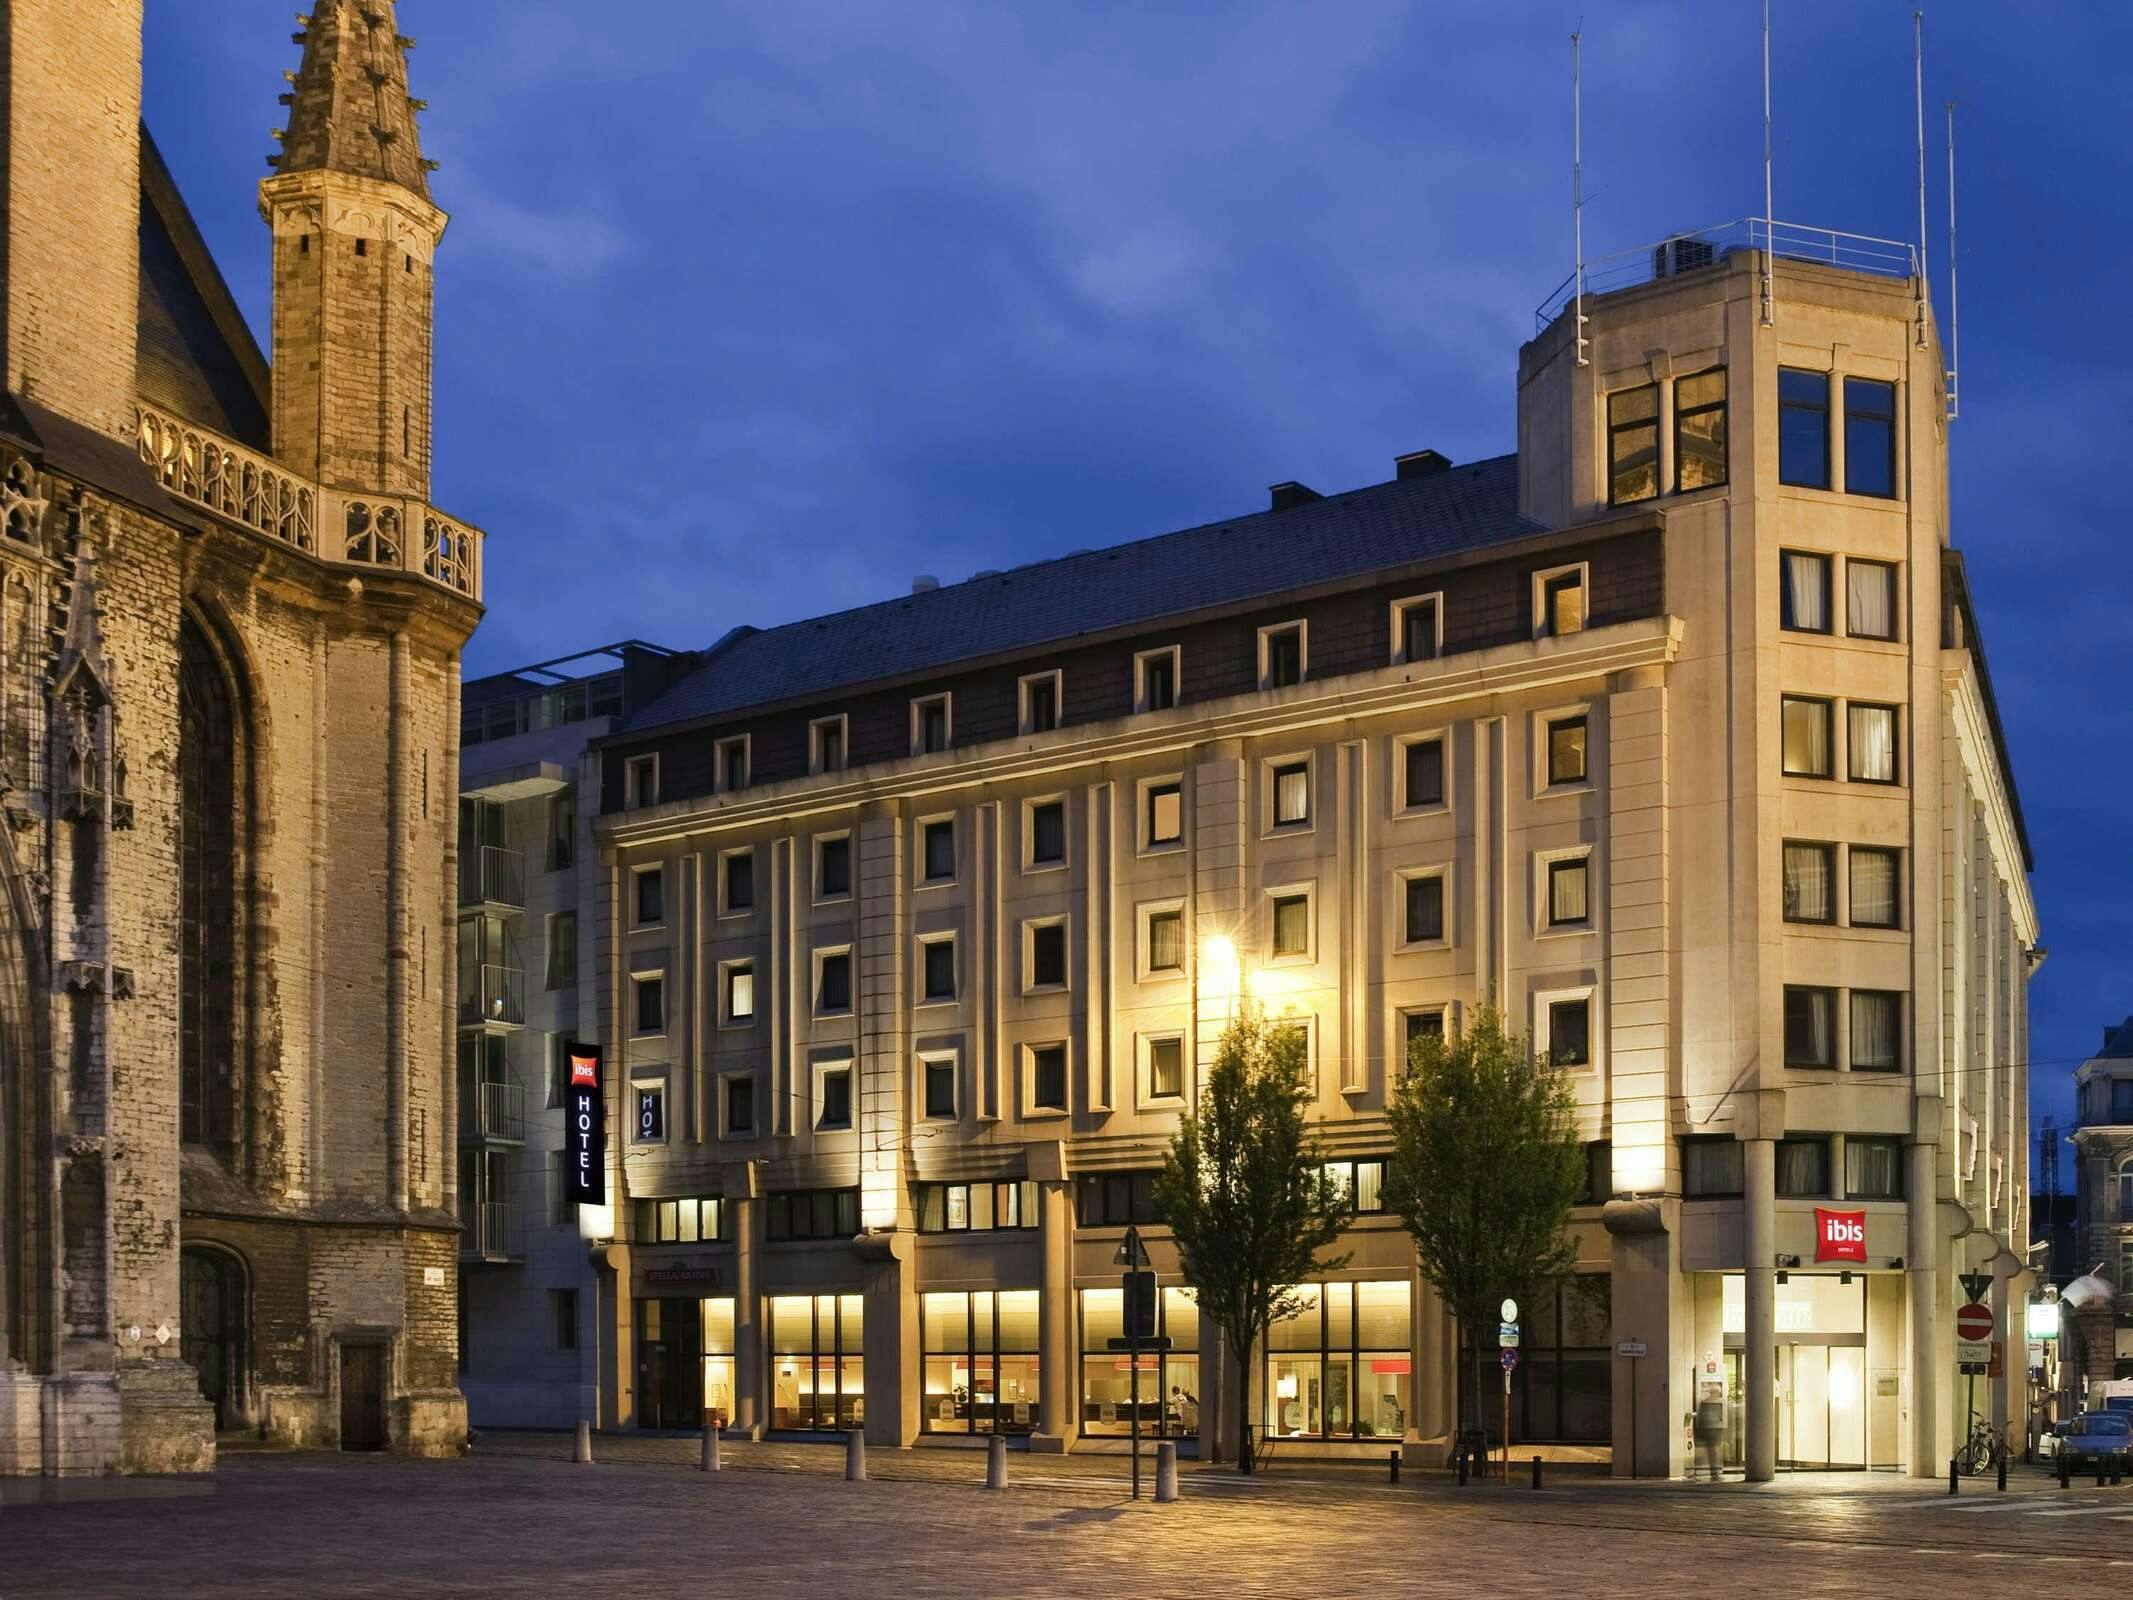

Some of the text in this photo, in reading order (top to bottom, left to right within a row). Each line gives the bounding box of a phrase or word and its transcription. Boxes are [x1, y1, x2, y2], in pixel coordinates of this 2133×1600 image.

[575, 1063, 593, 1077] ibis
[578, 1095, 591, 1188] HOTEL
[1827, 1219, 1864, 1242] ibis
